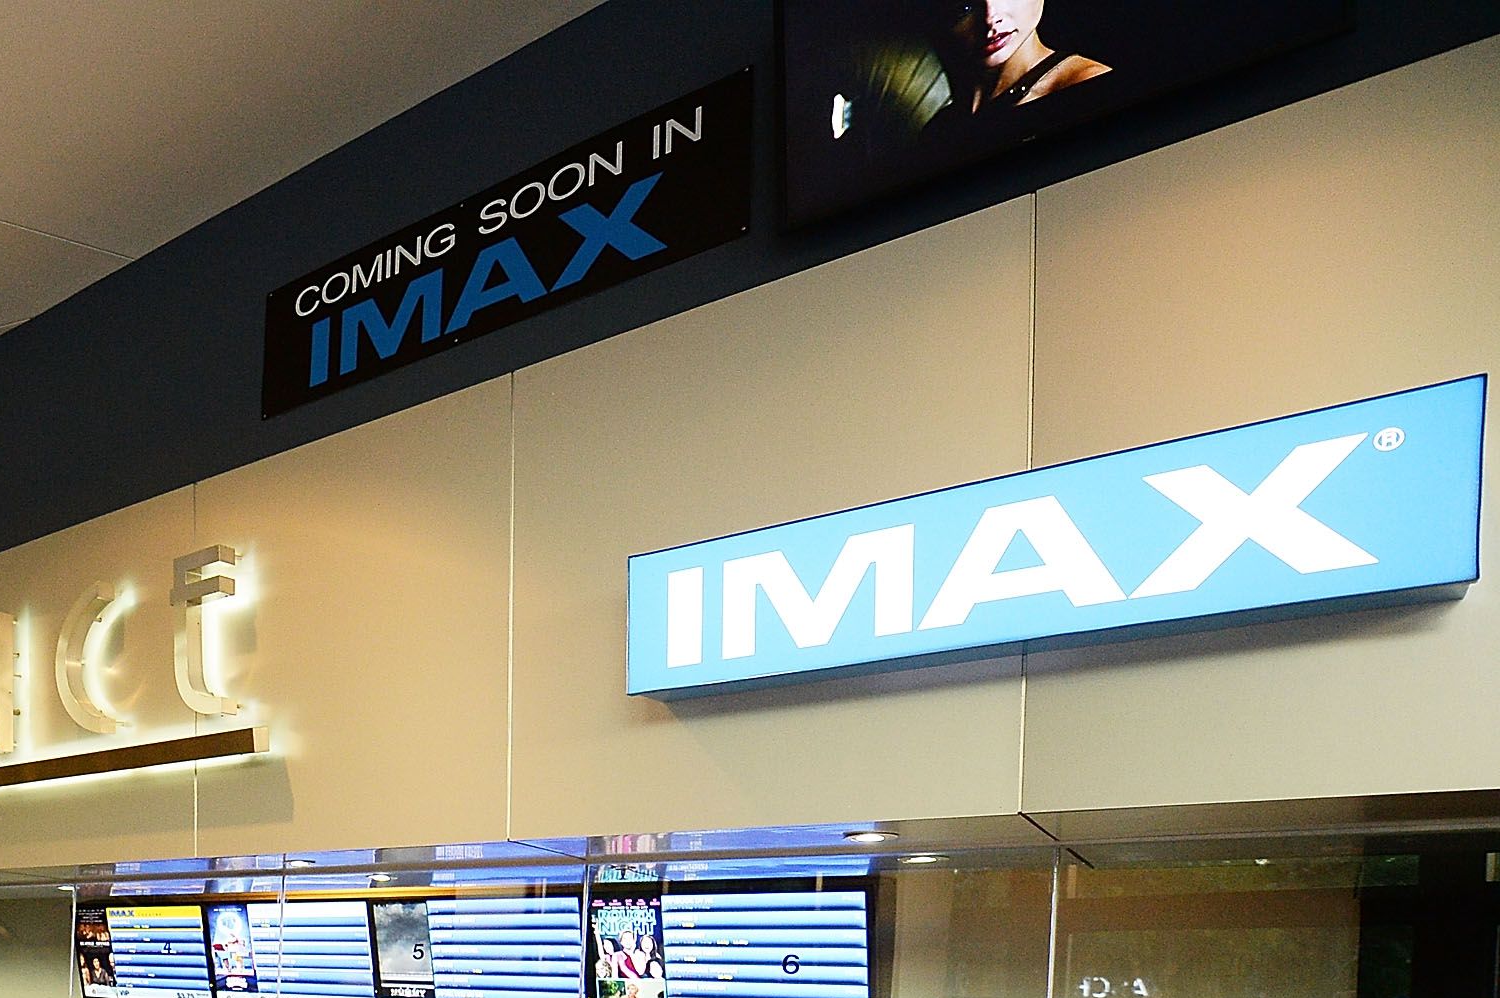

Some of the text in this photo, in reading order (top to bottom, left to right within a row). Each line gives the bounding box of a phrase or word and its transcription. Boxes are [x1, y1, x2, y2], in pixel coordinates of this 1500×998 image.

[295, 105, 703, 317] COMING SOON IN
[309, 171, 668, 388] IMAX
[666, 432, 1380, 669] IMAX
[108, 909, 135, 917] IMAX
[163, 941, 172, 954] 4
[412, 943, 424, 960] 5
[782, 954, 800, 974] 6
